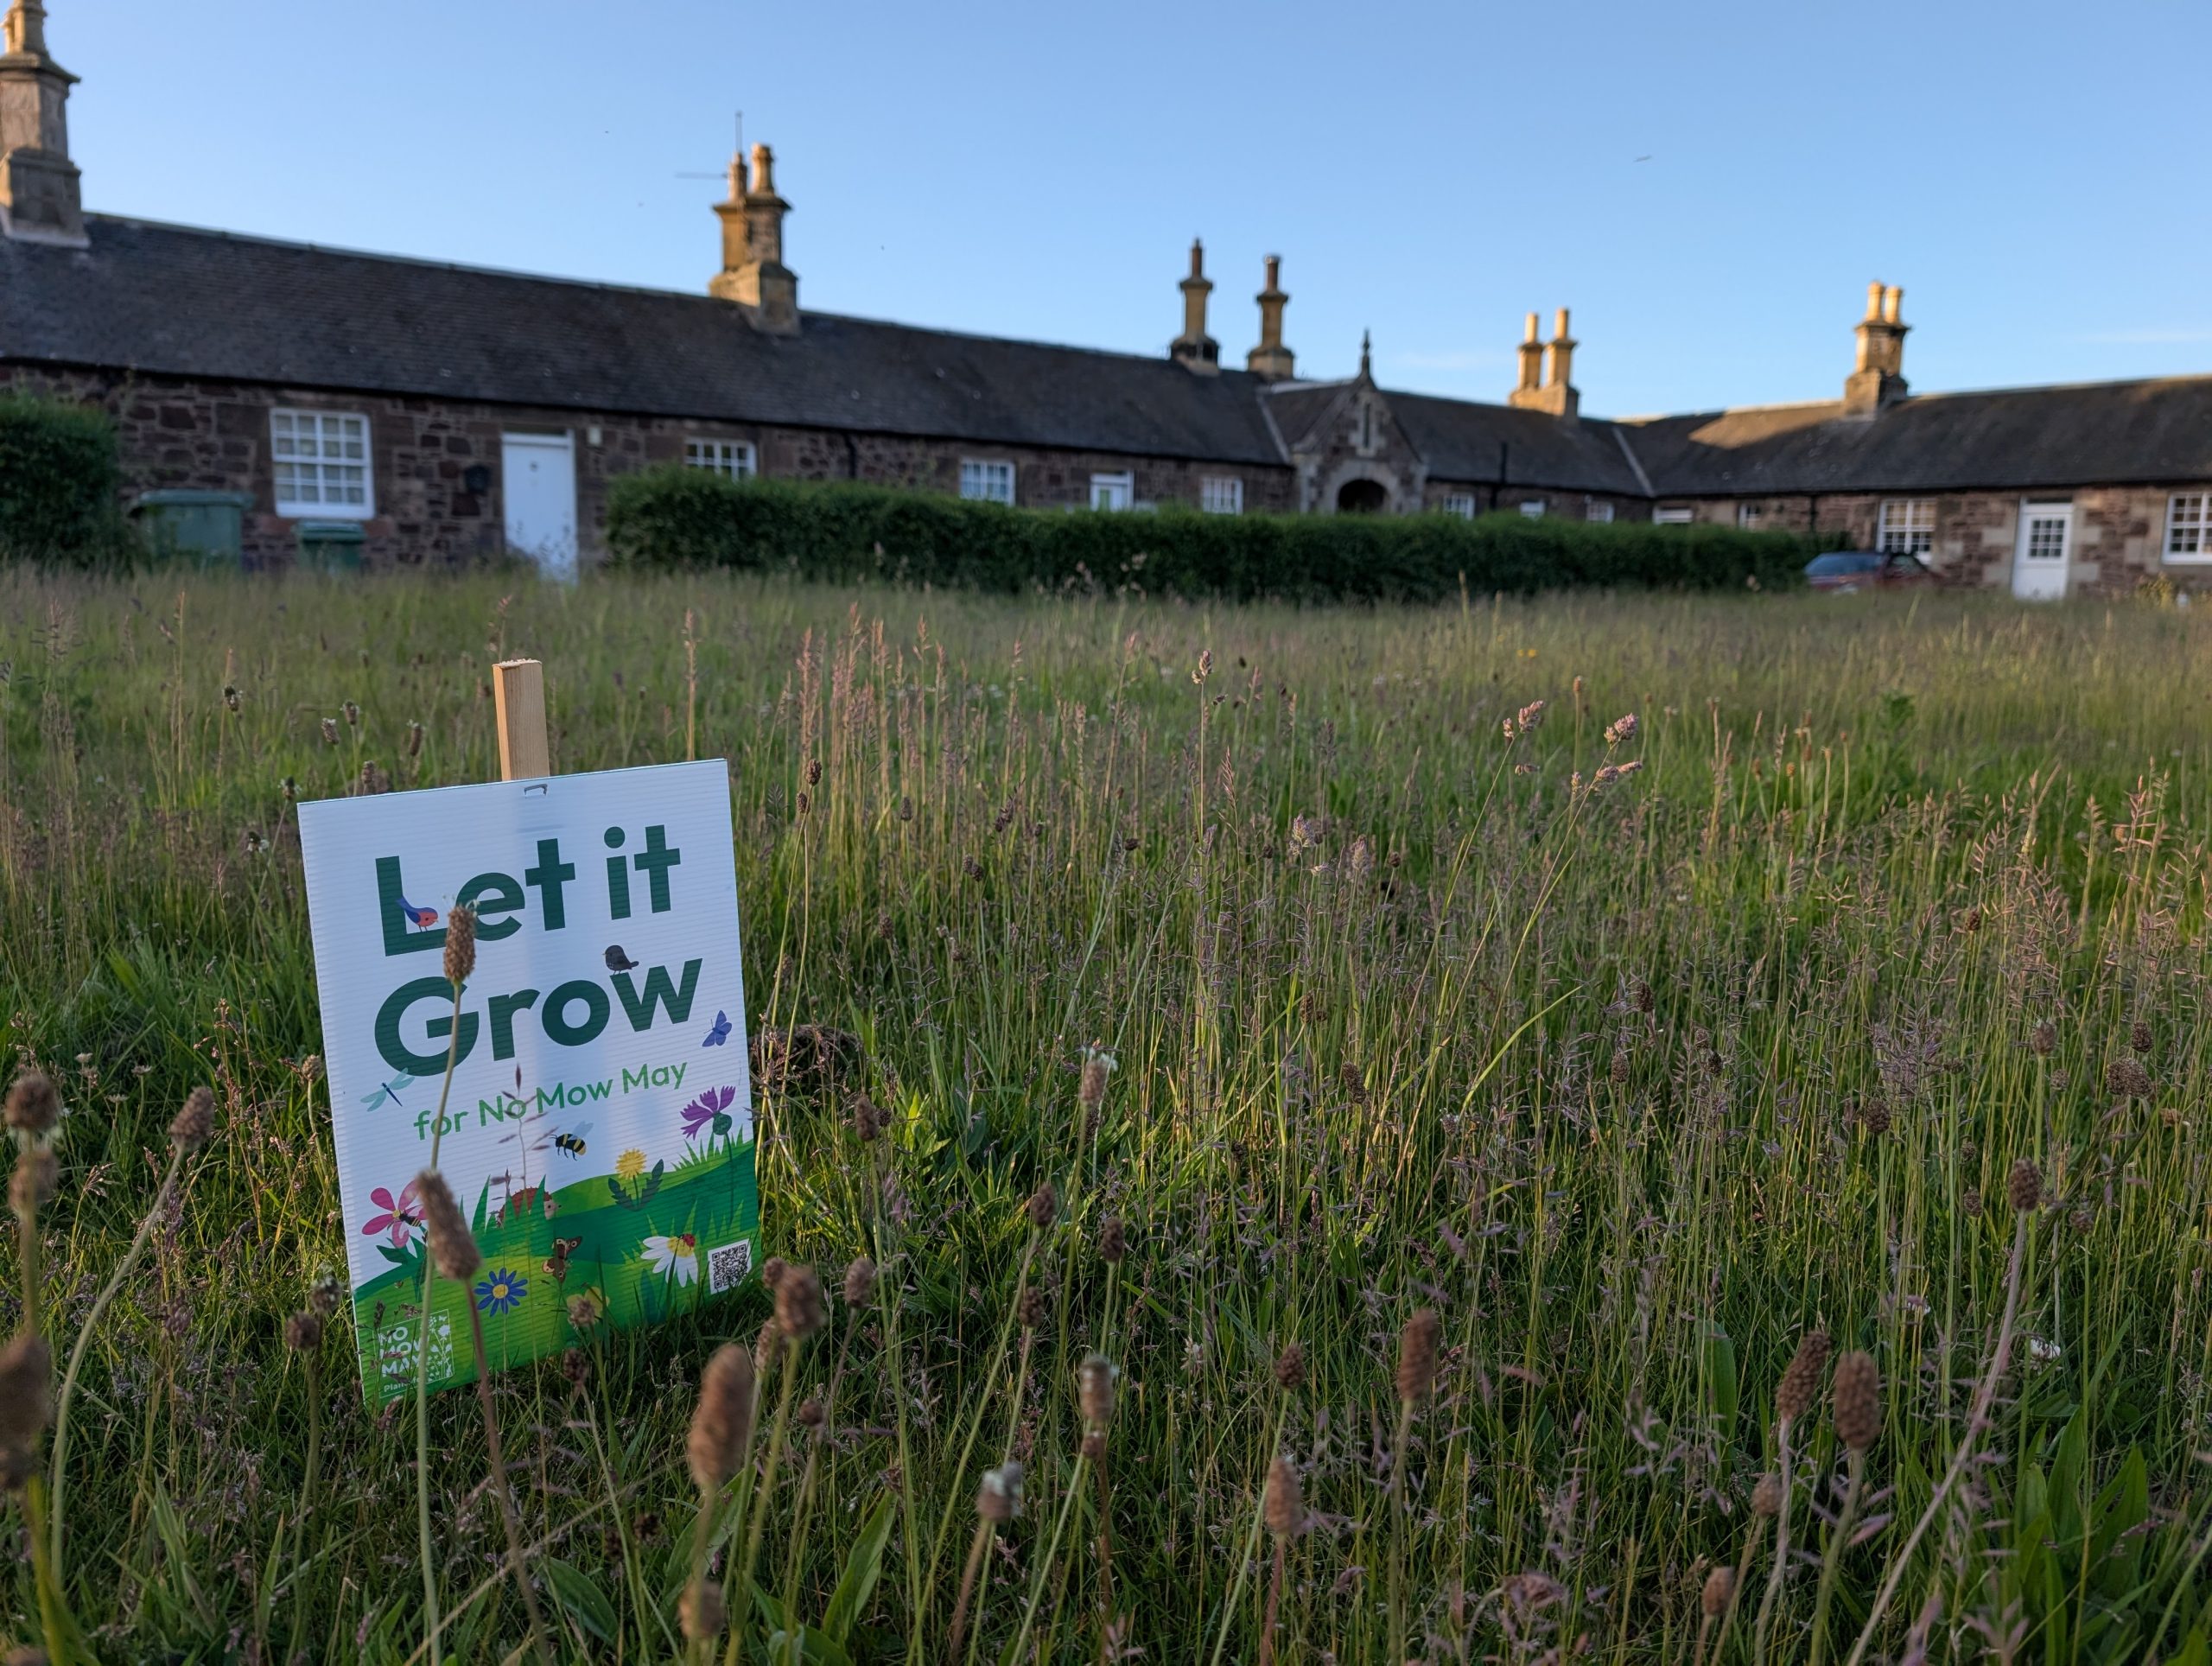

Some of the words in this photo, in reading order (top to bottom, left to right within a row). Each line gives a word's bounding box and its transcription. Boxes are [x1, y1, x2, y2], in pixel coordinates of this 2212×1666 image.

[375, 837, 576, 957] Let
[604, 824, 681, 920] it
[374, 957, 703, 1077] Grow
[414, 1110, 468, 1141] for
[478, 1096, 526, 1127] No
[536, 1079, 613, 1114] Mow
[621, 1062, 688, 1094] May
